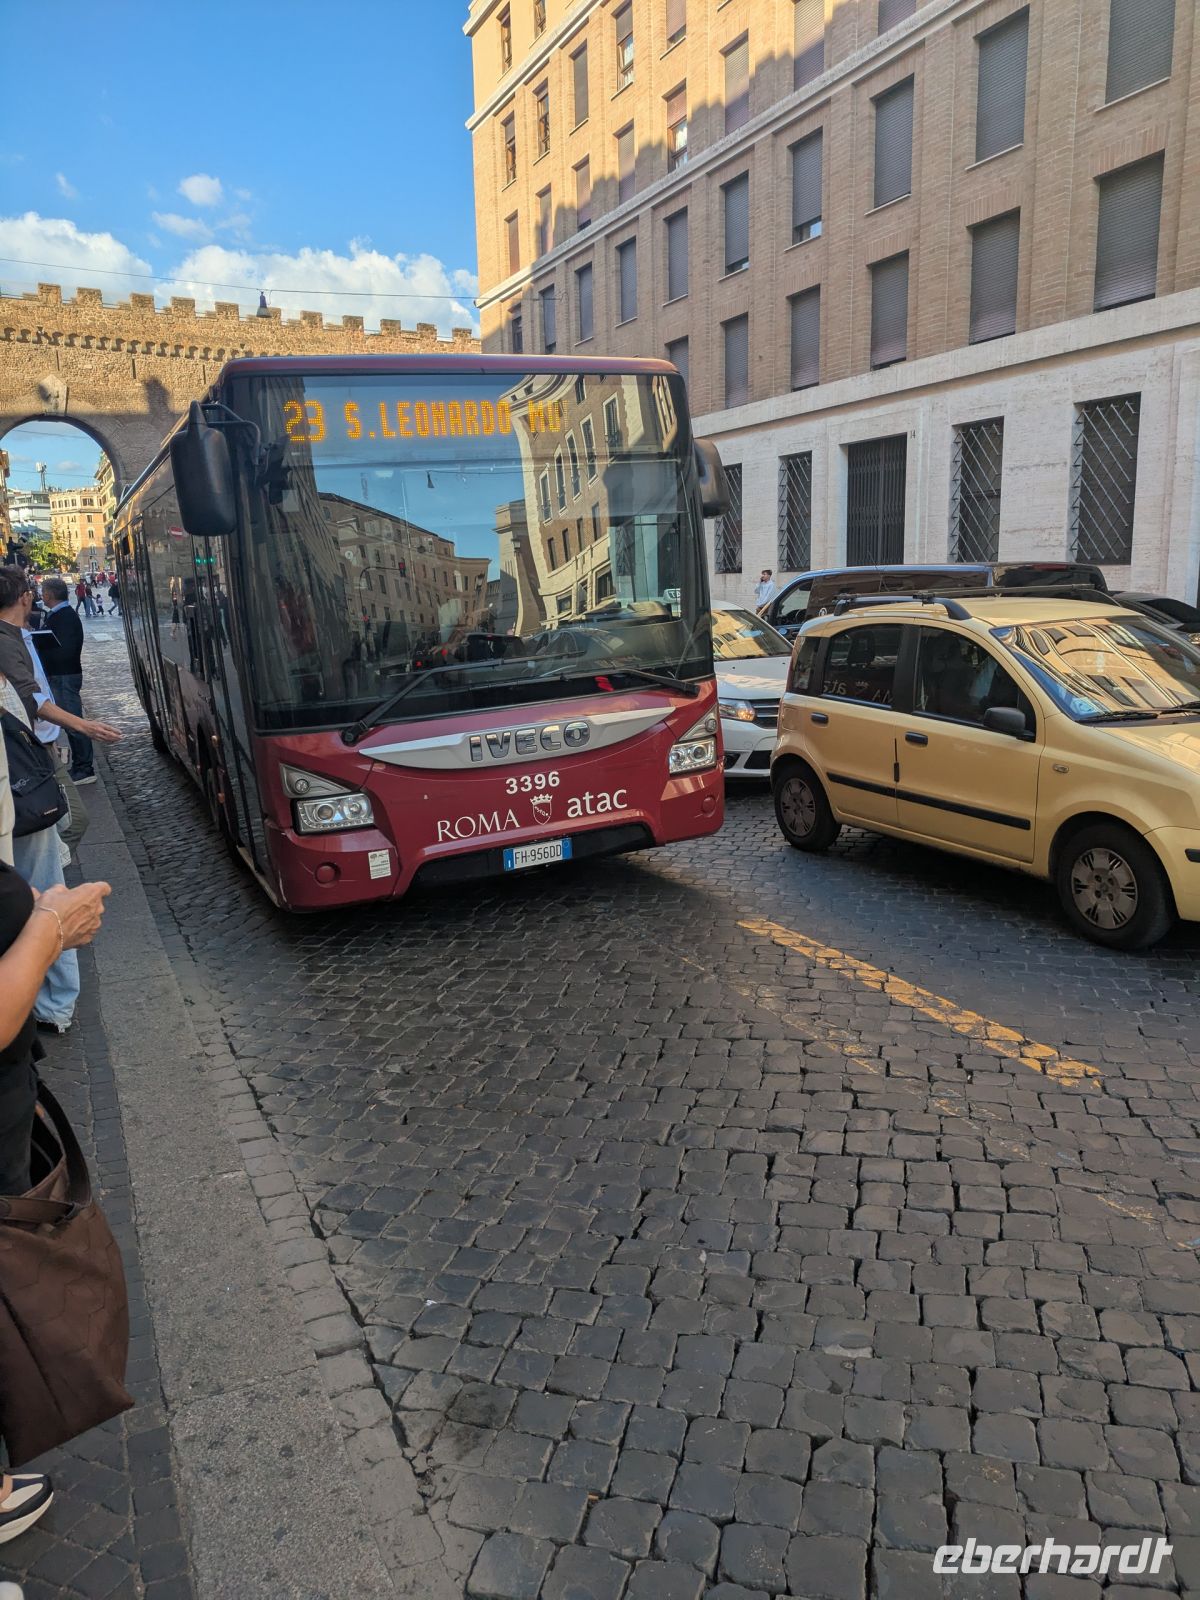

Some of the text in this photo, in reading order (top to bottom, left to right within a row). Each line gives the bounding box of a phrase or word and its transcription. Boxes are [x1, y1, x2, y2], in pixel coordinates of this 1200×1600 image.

[283, 400, 325, 441] 23
[469, 720, 591, 762] IVECO
[505, 771, 560, 795] 3396
[566, 789, 628, 818] atac
[437, 808, 521, 842] ROMA
